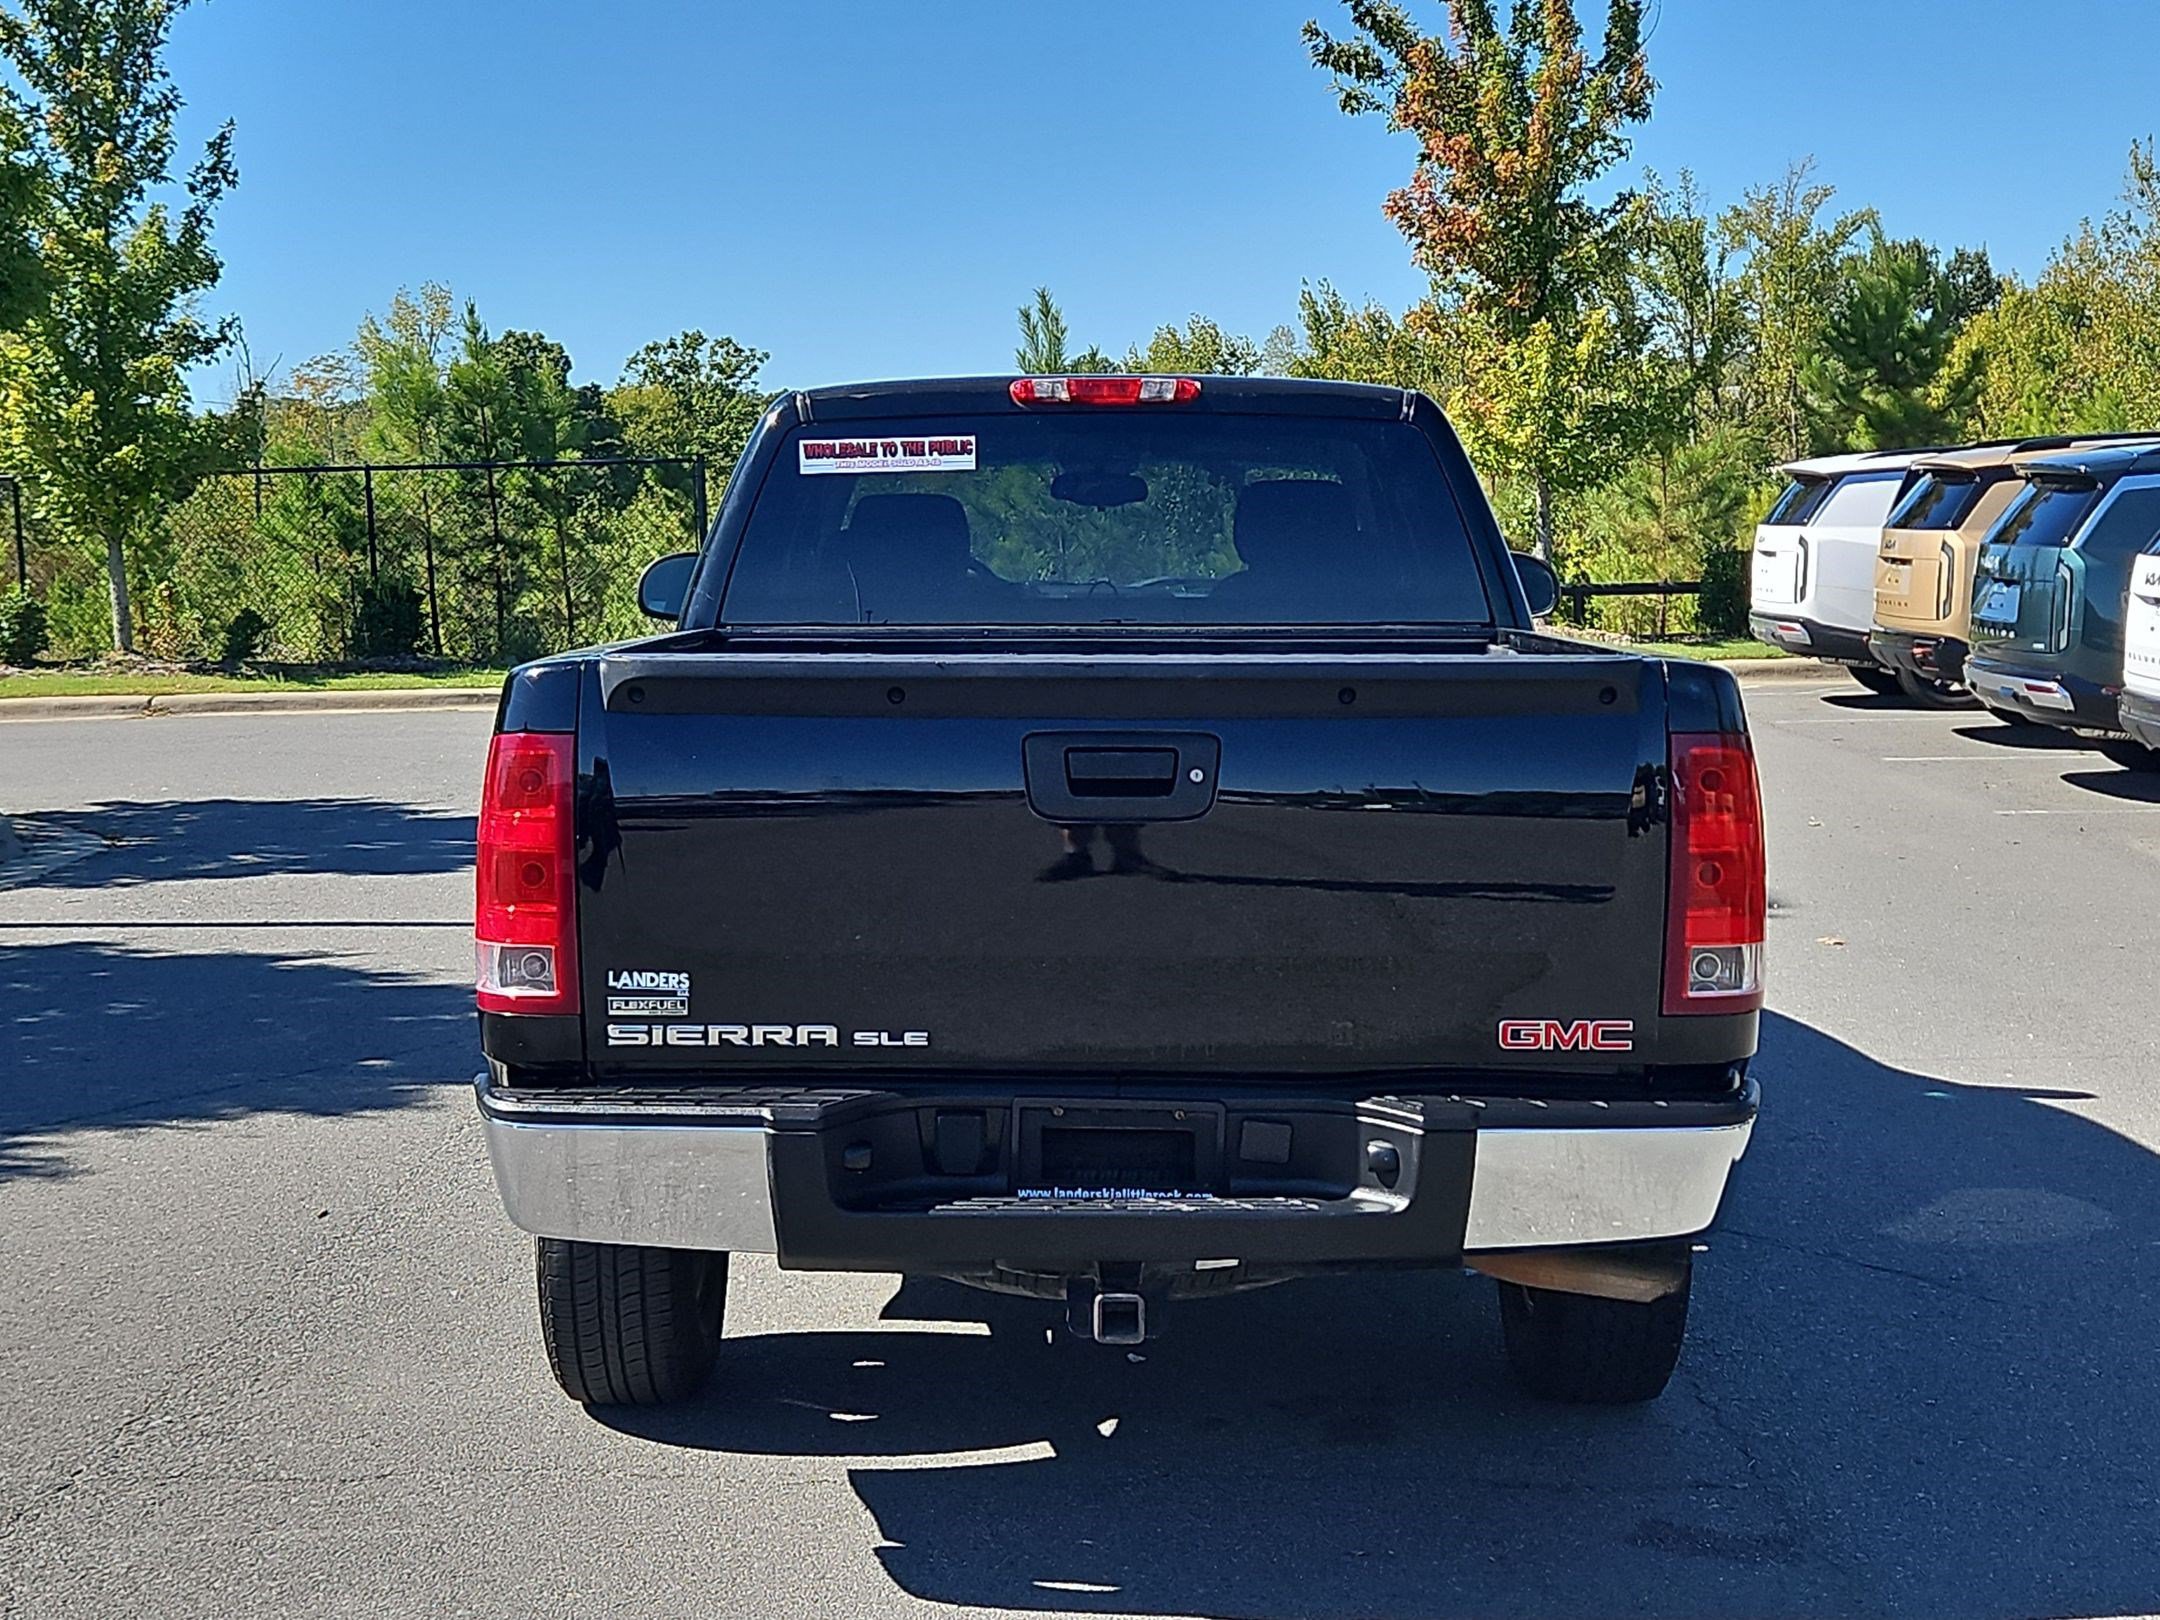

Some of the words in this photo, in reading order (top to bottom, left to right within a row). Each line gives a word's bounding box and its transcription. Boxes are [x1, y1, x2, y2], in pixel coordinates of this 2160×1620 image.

[803, 443, 877, 459] WHOLESALE
[881, 442, 898, 457] TO
[901, 441, 926, 457] THE
[928, 440, 973, 456] PUBLIC
[608, 970, 690, 989] LANDERS
[612, 1000, 685, 1010] FLEXFUEL
[607, 1023, 839, 1047] SIERRA
[853, 1031, 929, 1046] SLE
[1498, 1019, 1633, 1051] GMC
[1017, 1186, 1214, 1199] wwwlanderskialittlerockcom
